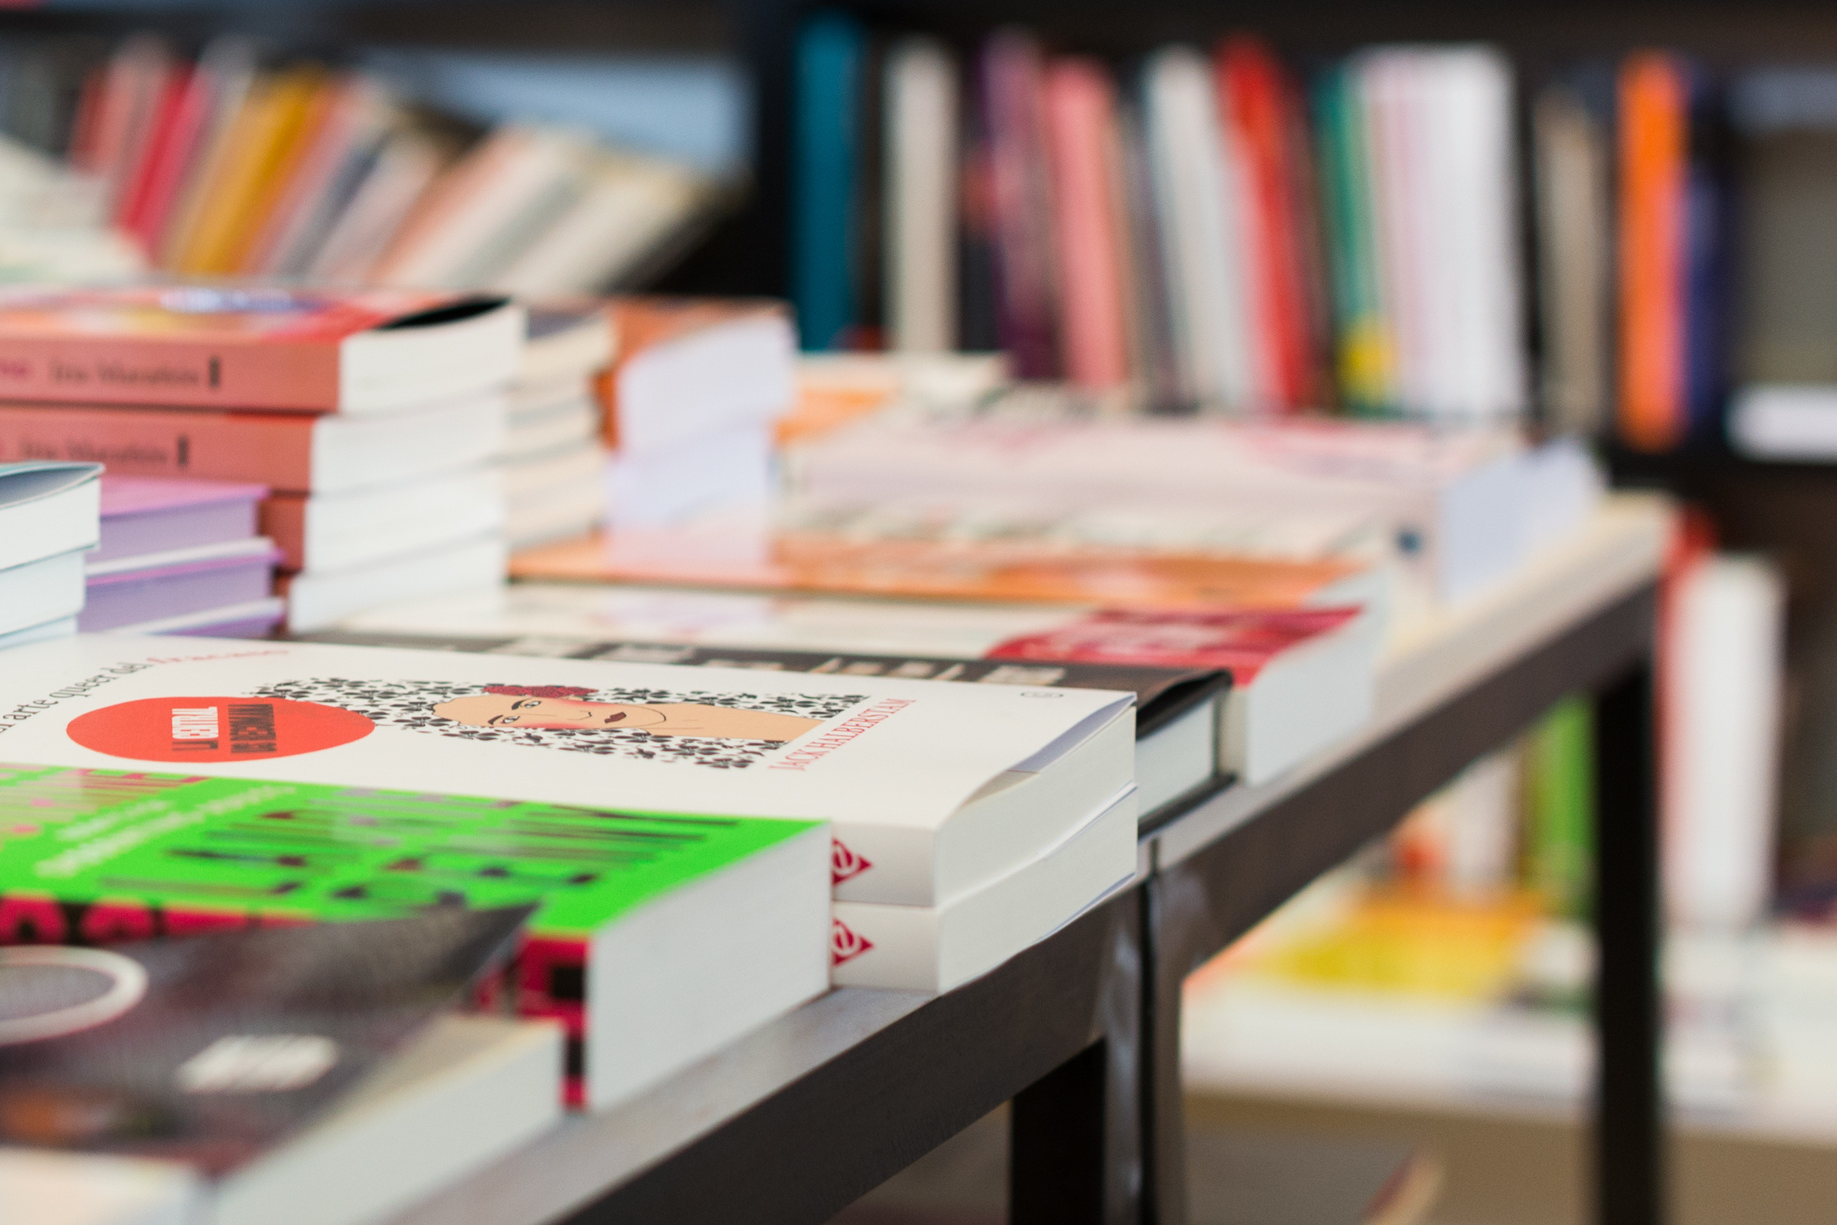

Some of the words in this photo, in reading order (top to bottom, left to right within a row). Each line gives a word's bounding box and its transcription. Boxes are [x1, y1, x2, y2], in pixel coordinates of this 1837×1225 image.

[2, 697, 59, 722] arte
[49, 674, 119, 700] queer
[99, 660, 155, 677] del
[171, 705, 220, 740] CENTRAL
[766, 748, 830, 772] JACK
[804, 697, 917, 750] HALBERSTAM
